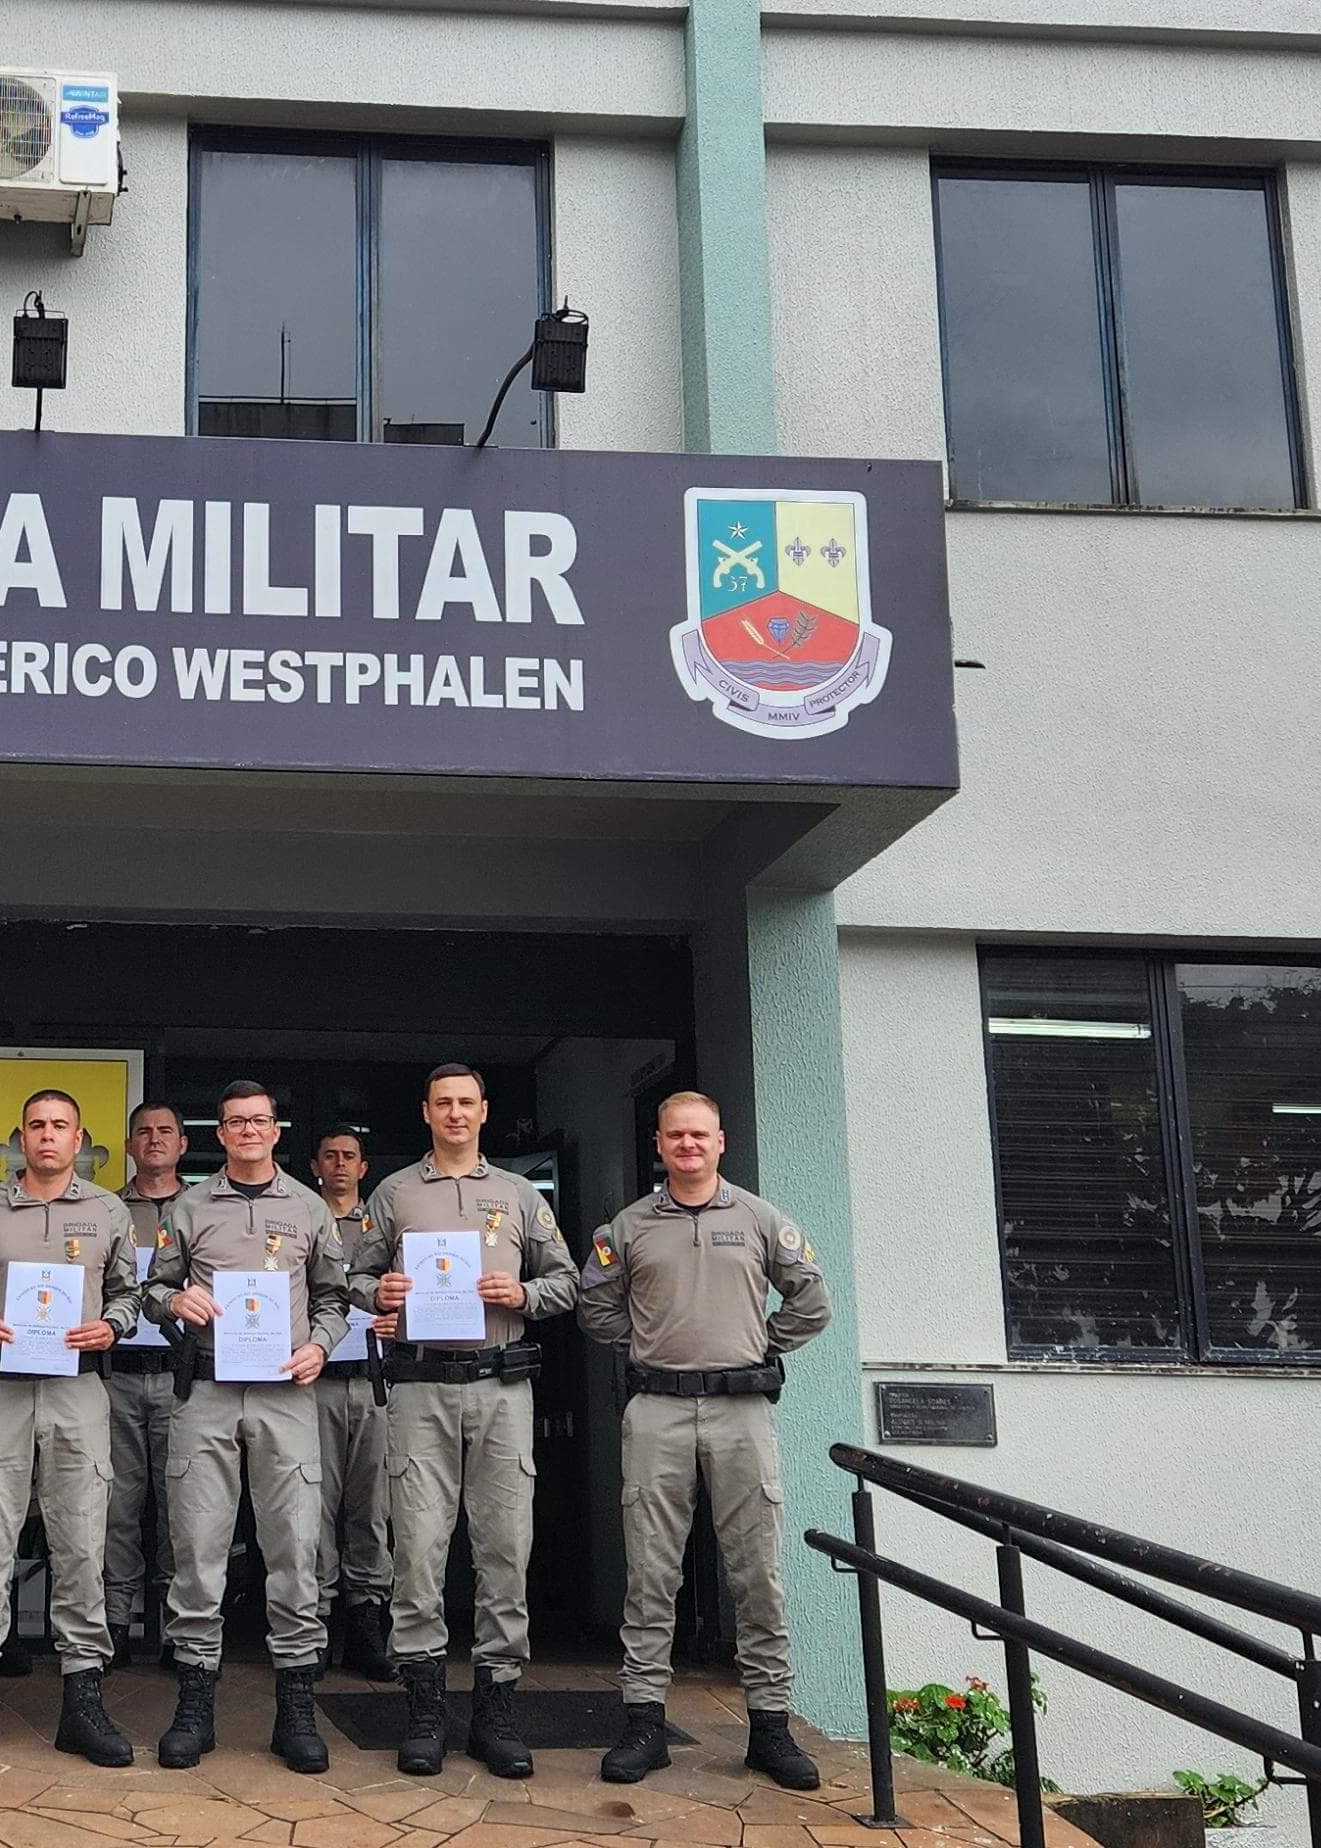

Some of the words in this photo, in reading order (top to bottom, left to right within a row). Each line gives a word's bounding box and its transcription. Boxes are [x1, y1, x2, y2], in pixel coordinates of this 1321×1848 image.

[100, 496, 585, 625] MILITAR
[172, 646, 584, 712] WESTPHALEN
[718, 679, 750, 703] CIVIS
[768, 712, 800, 721] MMIV
[809, 671, 860, 708] PROTECTOR
